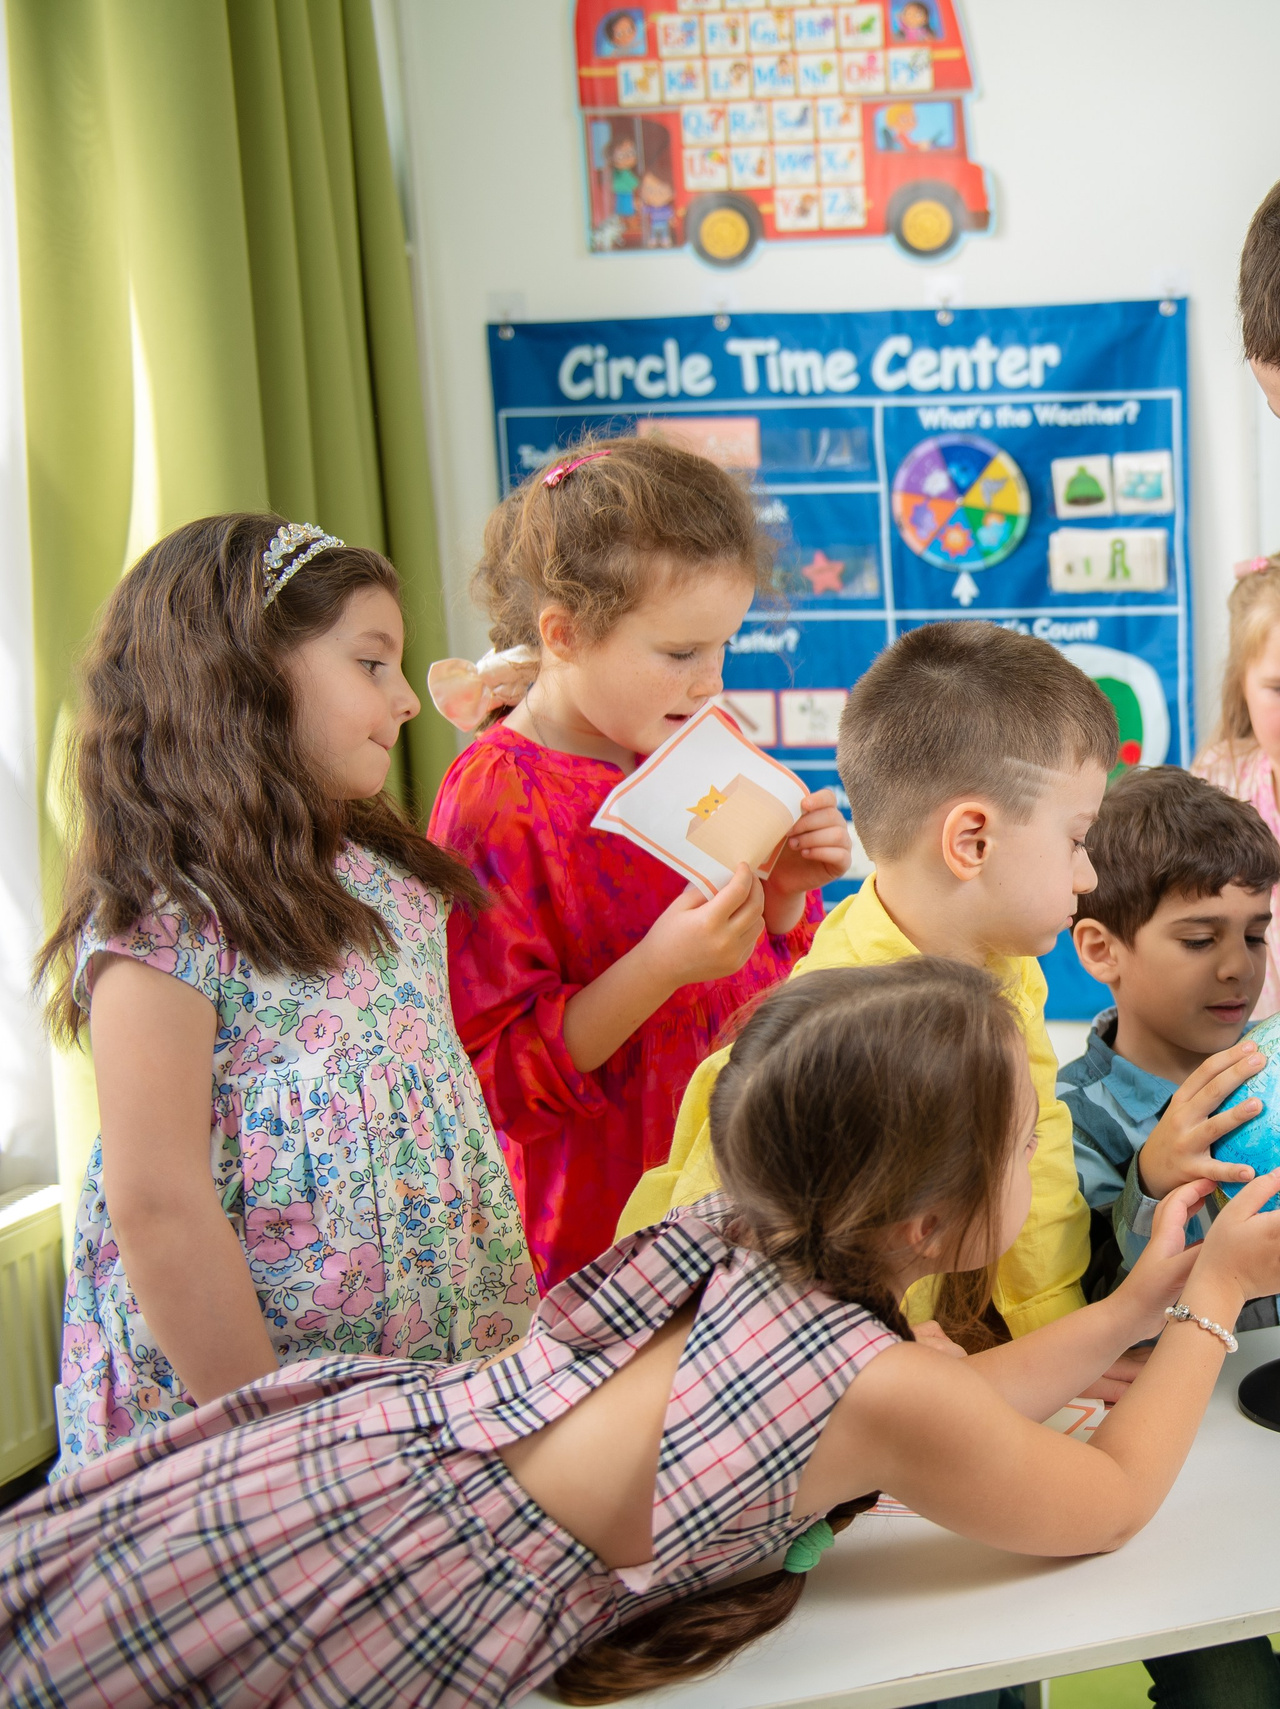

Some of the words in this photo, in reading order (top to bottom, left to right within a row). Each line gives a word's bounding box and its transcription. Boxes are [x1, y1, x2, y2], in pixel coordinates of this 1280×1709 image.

[558, 339, 715, 400] Circle
[726, 338, 860, 395] Time
[871, 336, 1061, 392] Center
[917, 405, 993, 431] What's
[995, 405, 1032, 429] the
[1033, 399, 1141, 427] Weather?
[1032, 617, 1099, 641] Count
